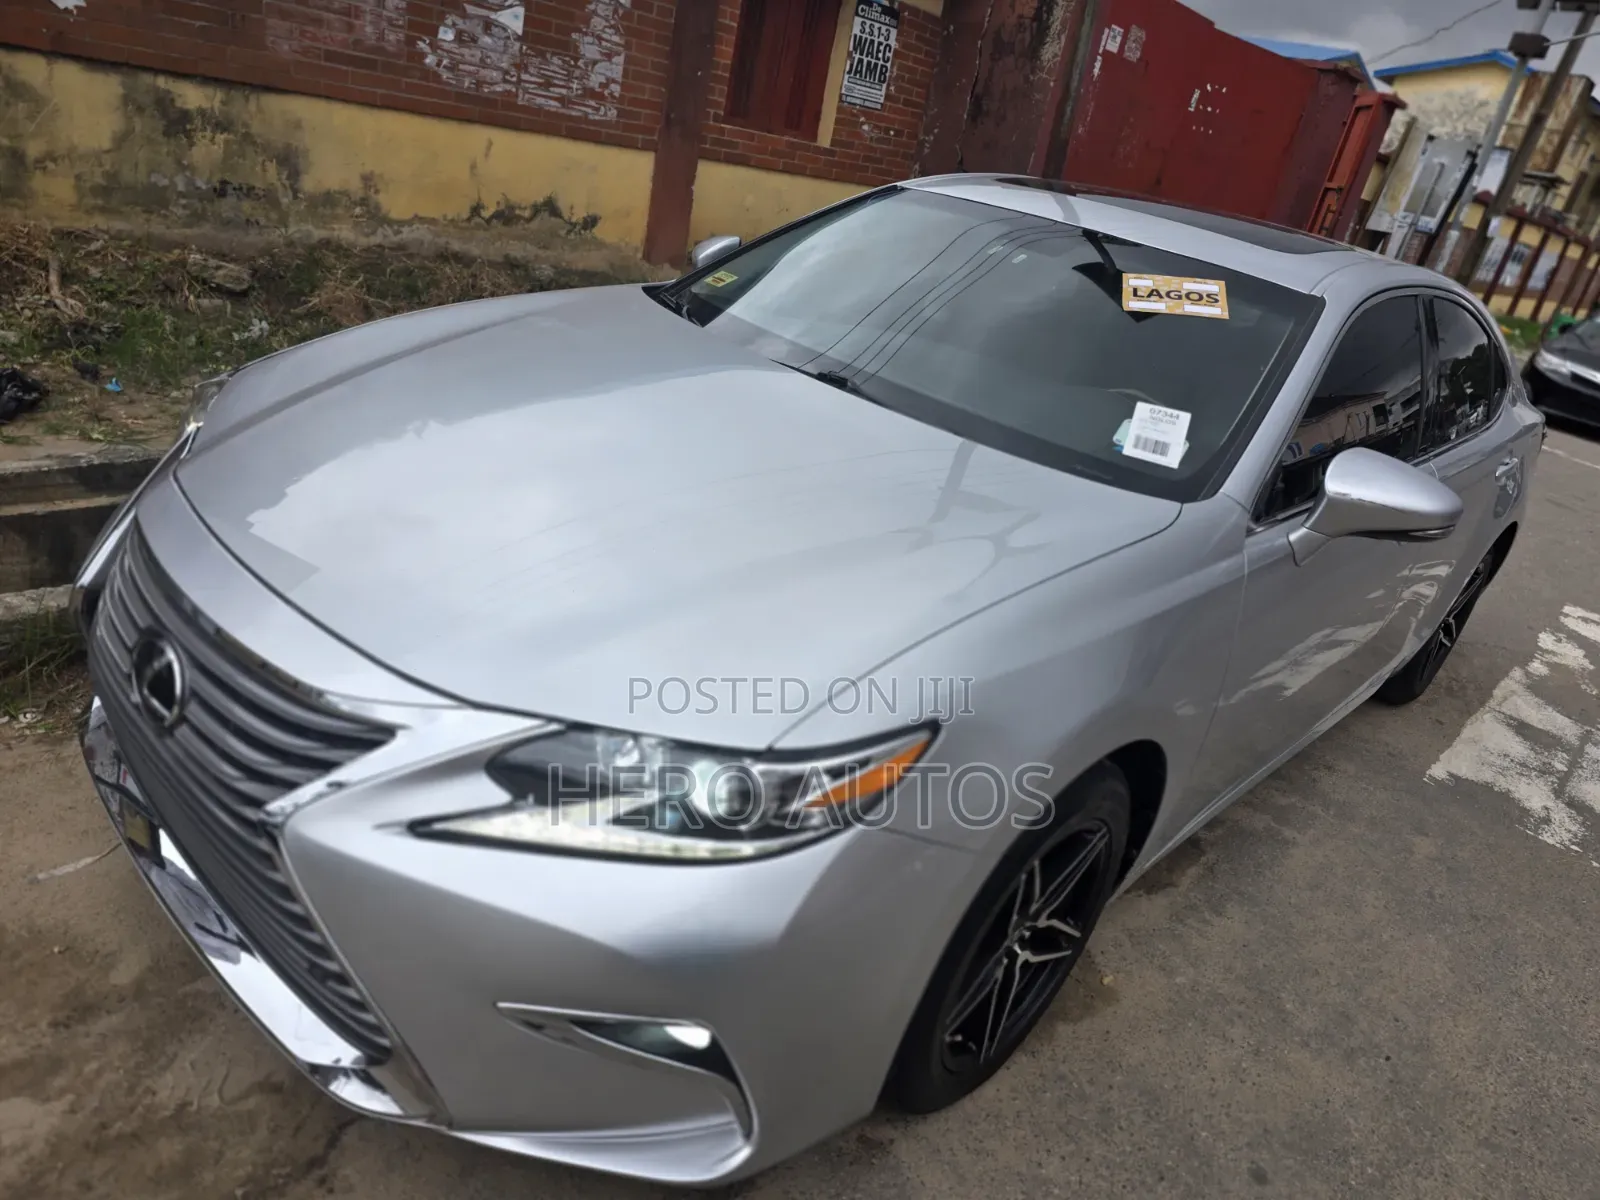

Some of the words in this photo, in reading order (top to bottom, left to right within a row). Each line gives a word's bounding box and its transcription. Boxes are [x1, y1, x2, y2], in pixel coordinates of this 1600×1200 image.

[858, 4, 891, 24] Climax
[853, 33, 892, 64] WAEC
[847, 56, 889, 85] JAMB
[1132, 287, 1220, 304] LAGOS
